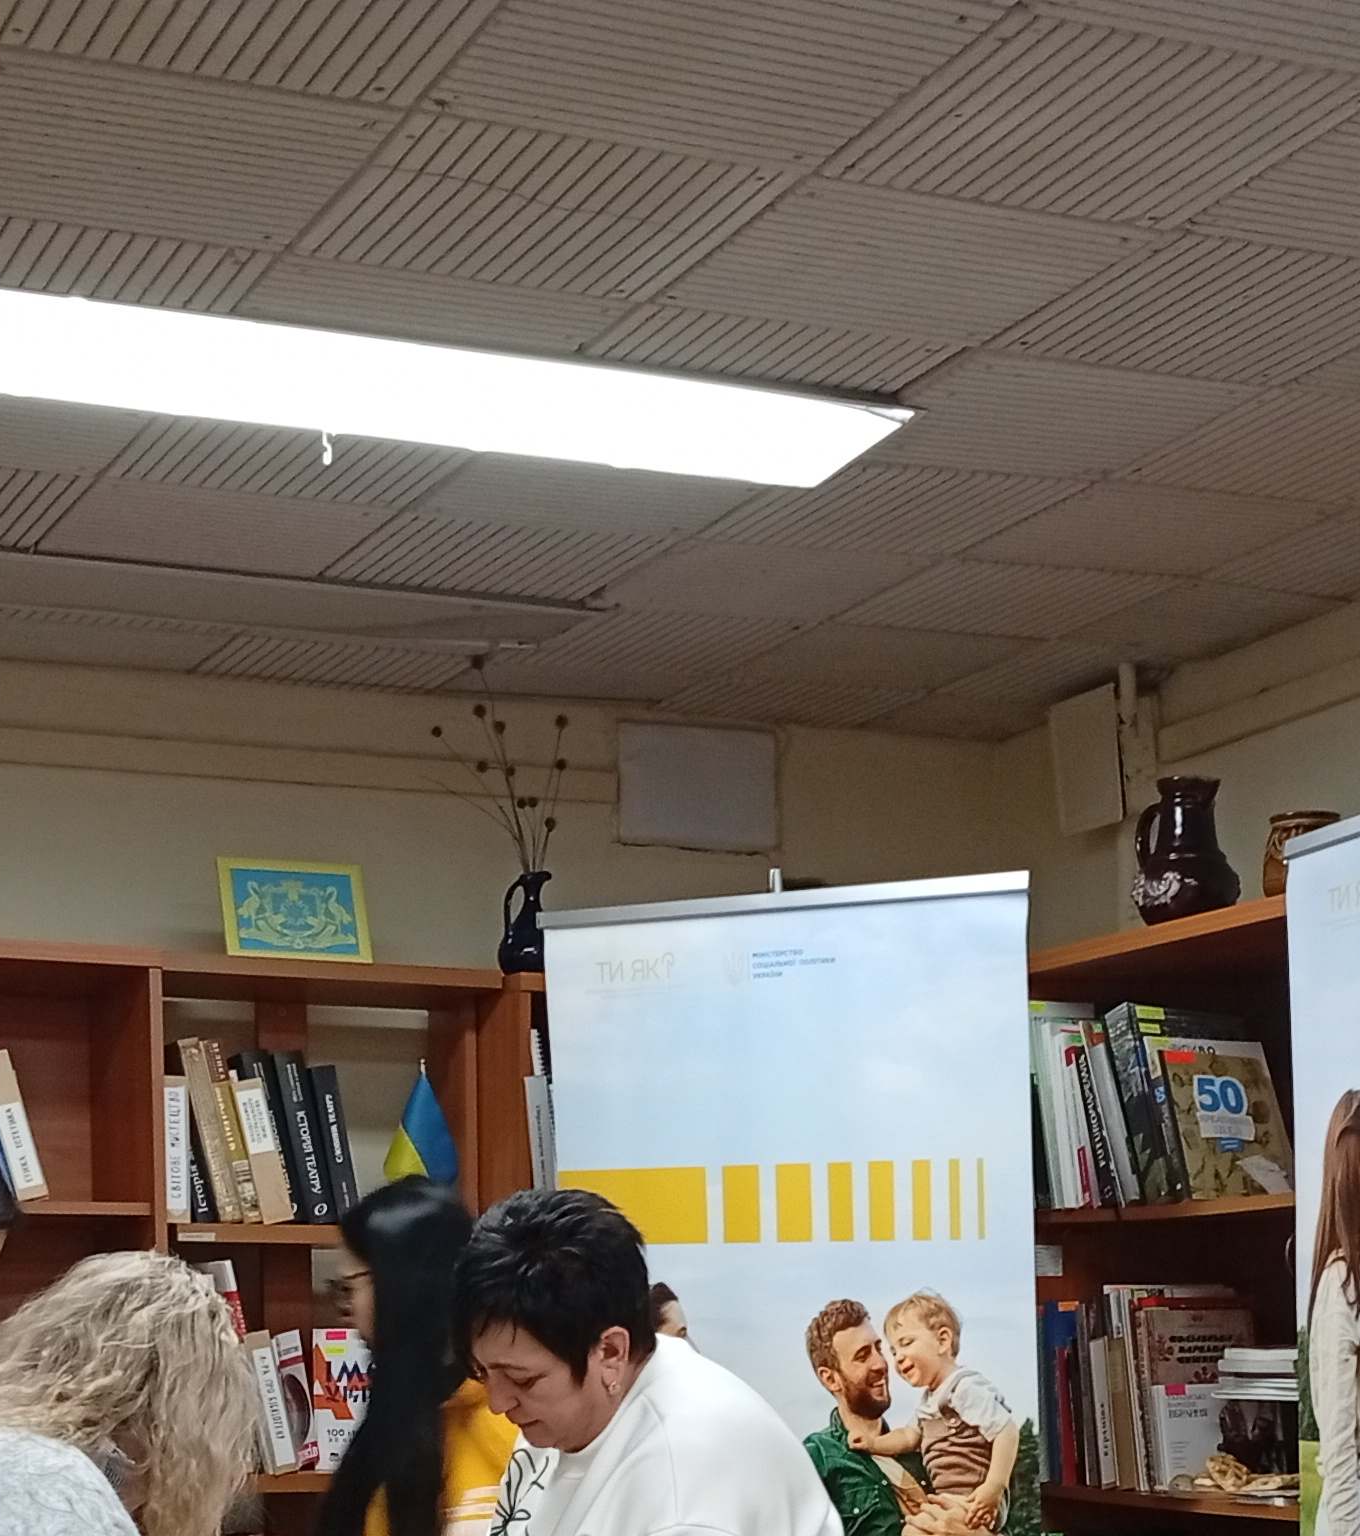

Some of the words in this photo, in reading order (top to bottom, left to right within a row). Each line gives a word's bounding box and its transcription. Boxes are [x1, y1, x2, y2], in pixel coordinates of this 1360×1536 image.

[595, 961, 625, 984] ТИ
[631, 952, 675, 982] ЯК?
[1197, 1077, 1244, 1114] 50
[296, 1110, 313, 1153] ІСТОРІЯ
[305, 1150, 323, 1195] ТЕАТРУ
[326, 1428, 345, 1437] 100
